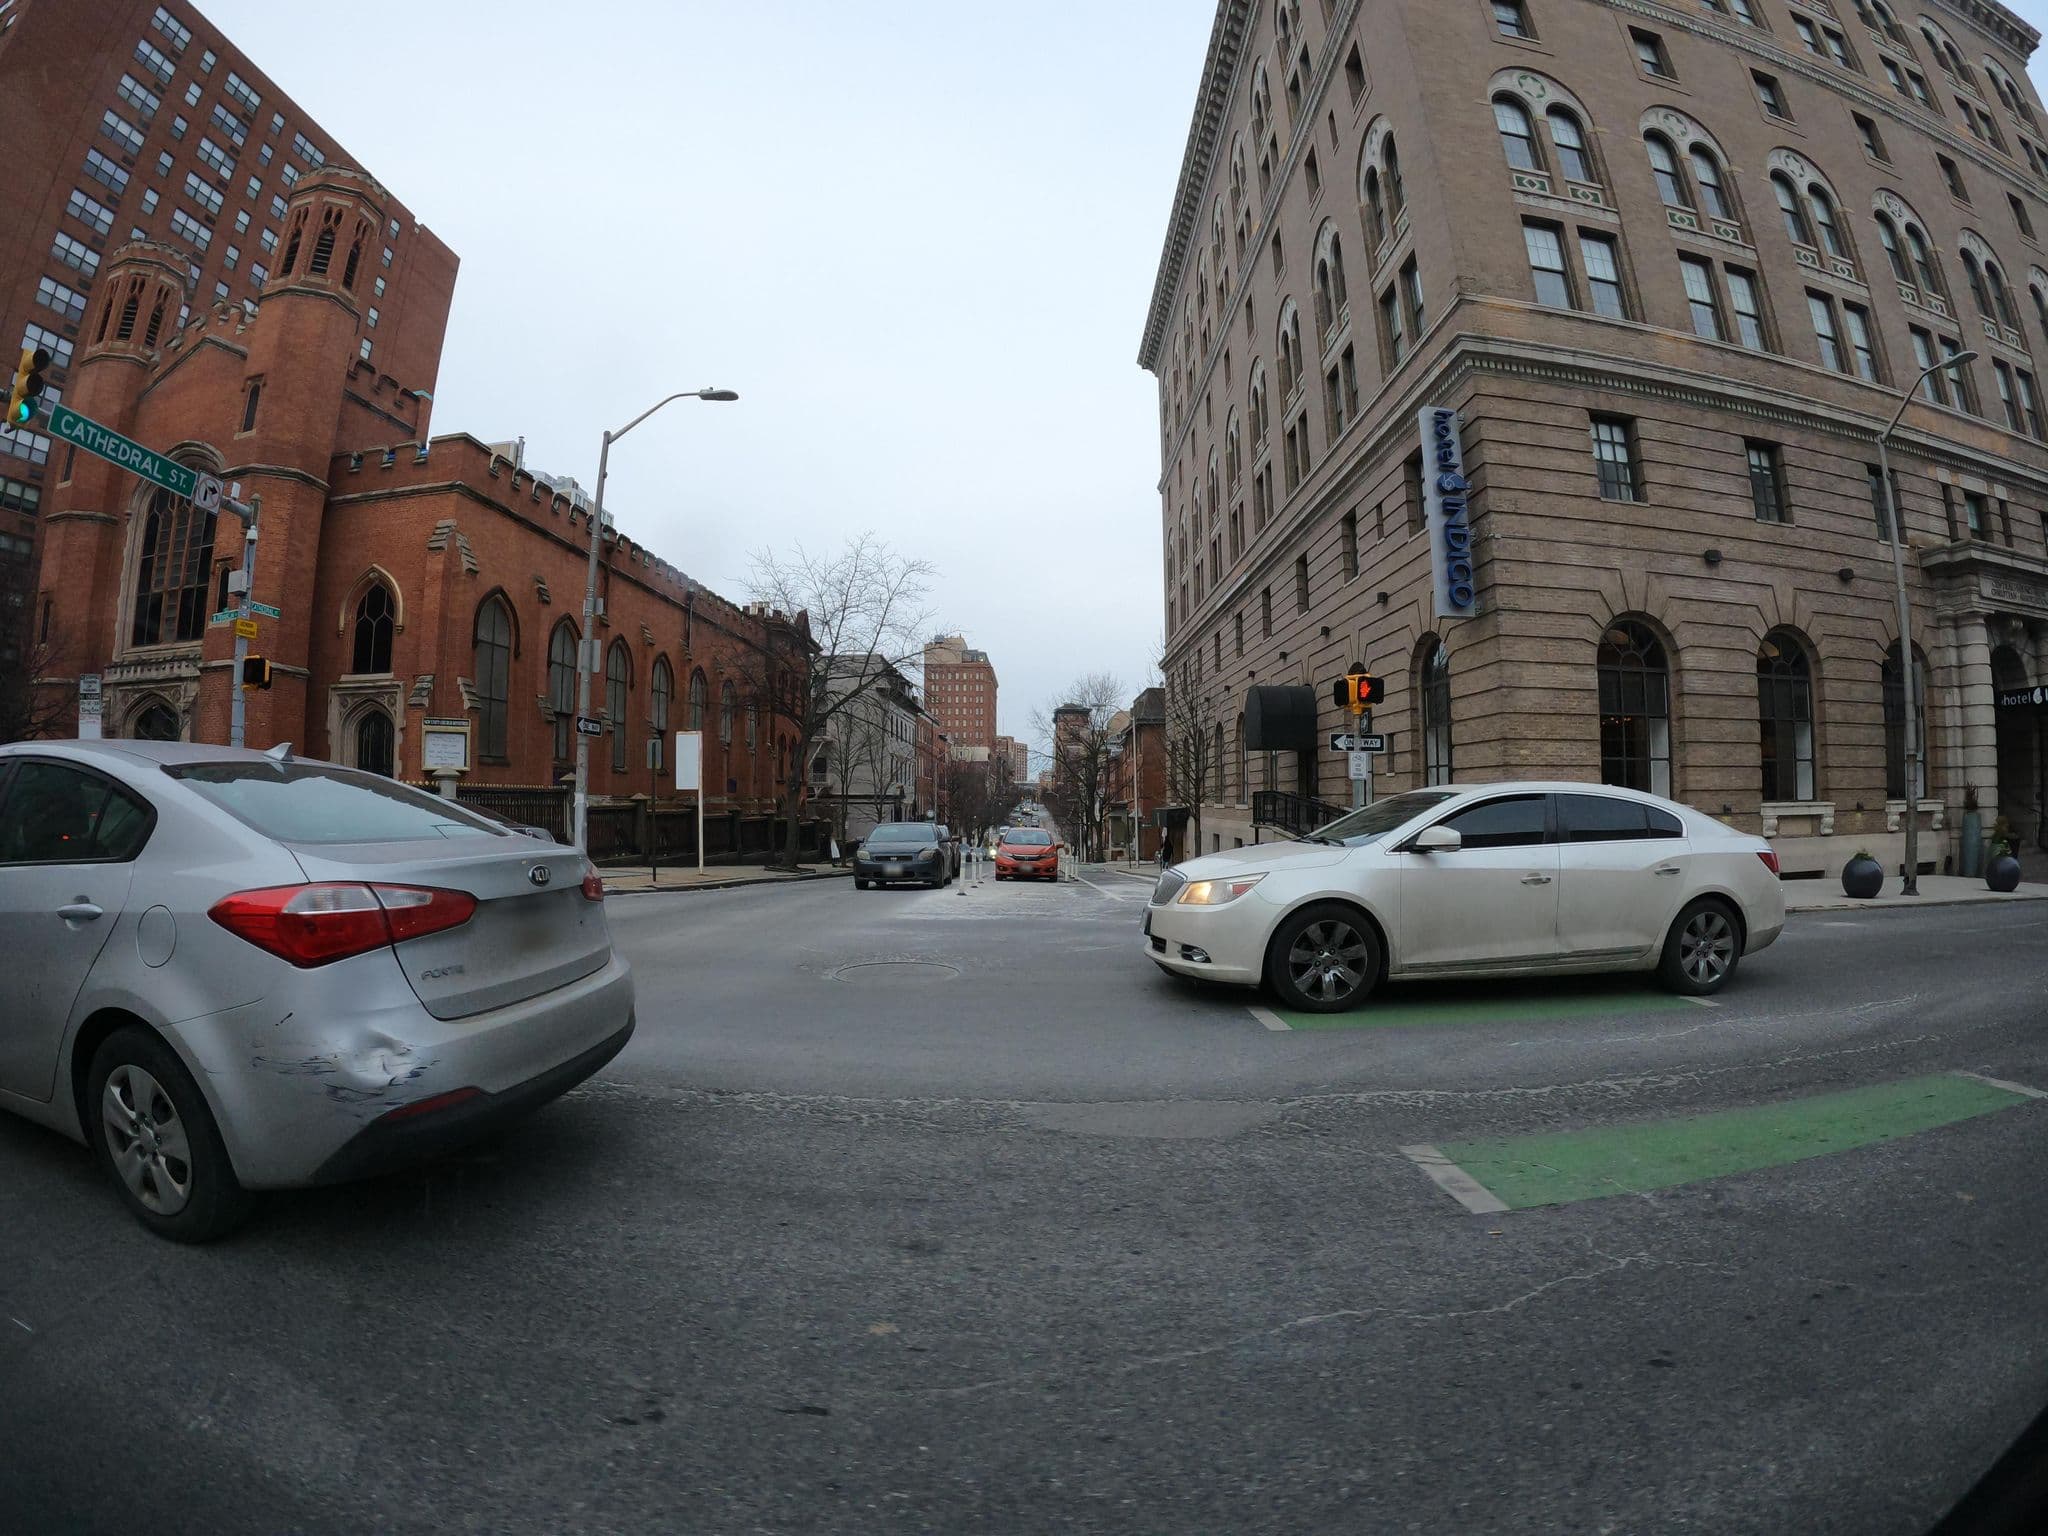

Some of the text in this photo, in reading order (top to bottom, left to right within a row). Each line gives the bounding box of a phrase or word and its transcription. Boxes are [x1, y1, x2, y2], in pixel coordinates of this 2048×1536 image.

[60, 414, 186, 488] CATHEDRAL ST.
[1434, 410, 1474, 608] hotel INDIGO
[2003, 691, 2031, 706] hotel
